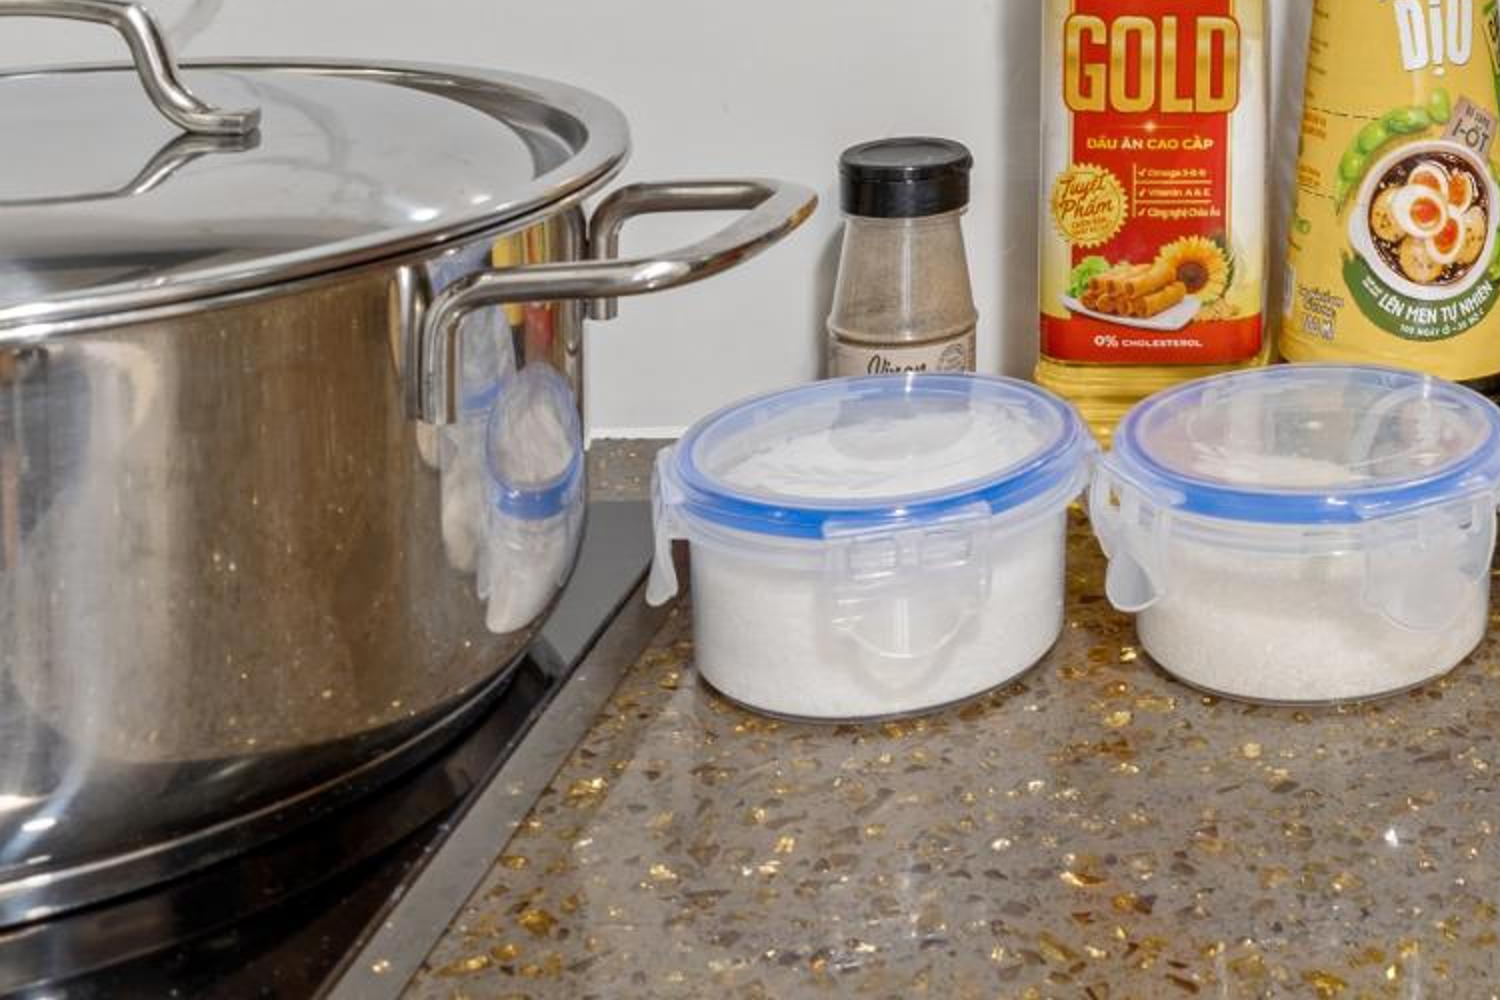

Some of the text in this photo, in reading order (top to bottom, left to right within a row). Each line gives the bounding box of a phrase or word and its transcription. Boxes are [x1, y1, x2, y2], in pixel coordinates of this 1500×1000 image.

[1063, 13, 1241, 114] GOLD
[1147, 138, 1179, 150] CAO
[1378, 292, 1405, 317] LÊN
[1405, 305, 1437, 324] MEN
[1093, 335, 1203, 347] 0% CHOLESTEROL
